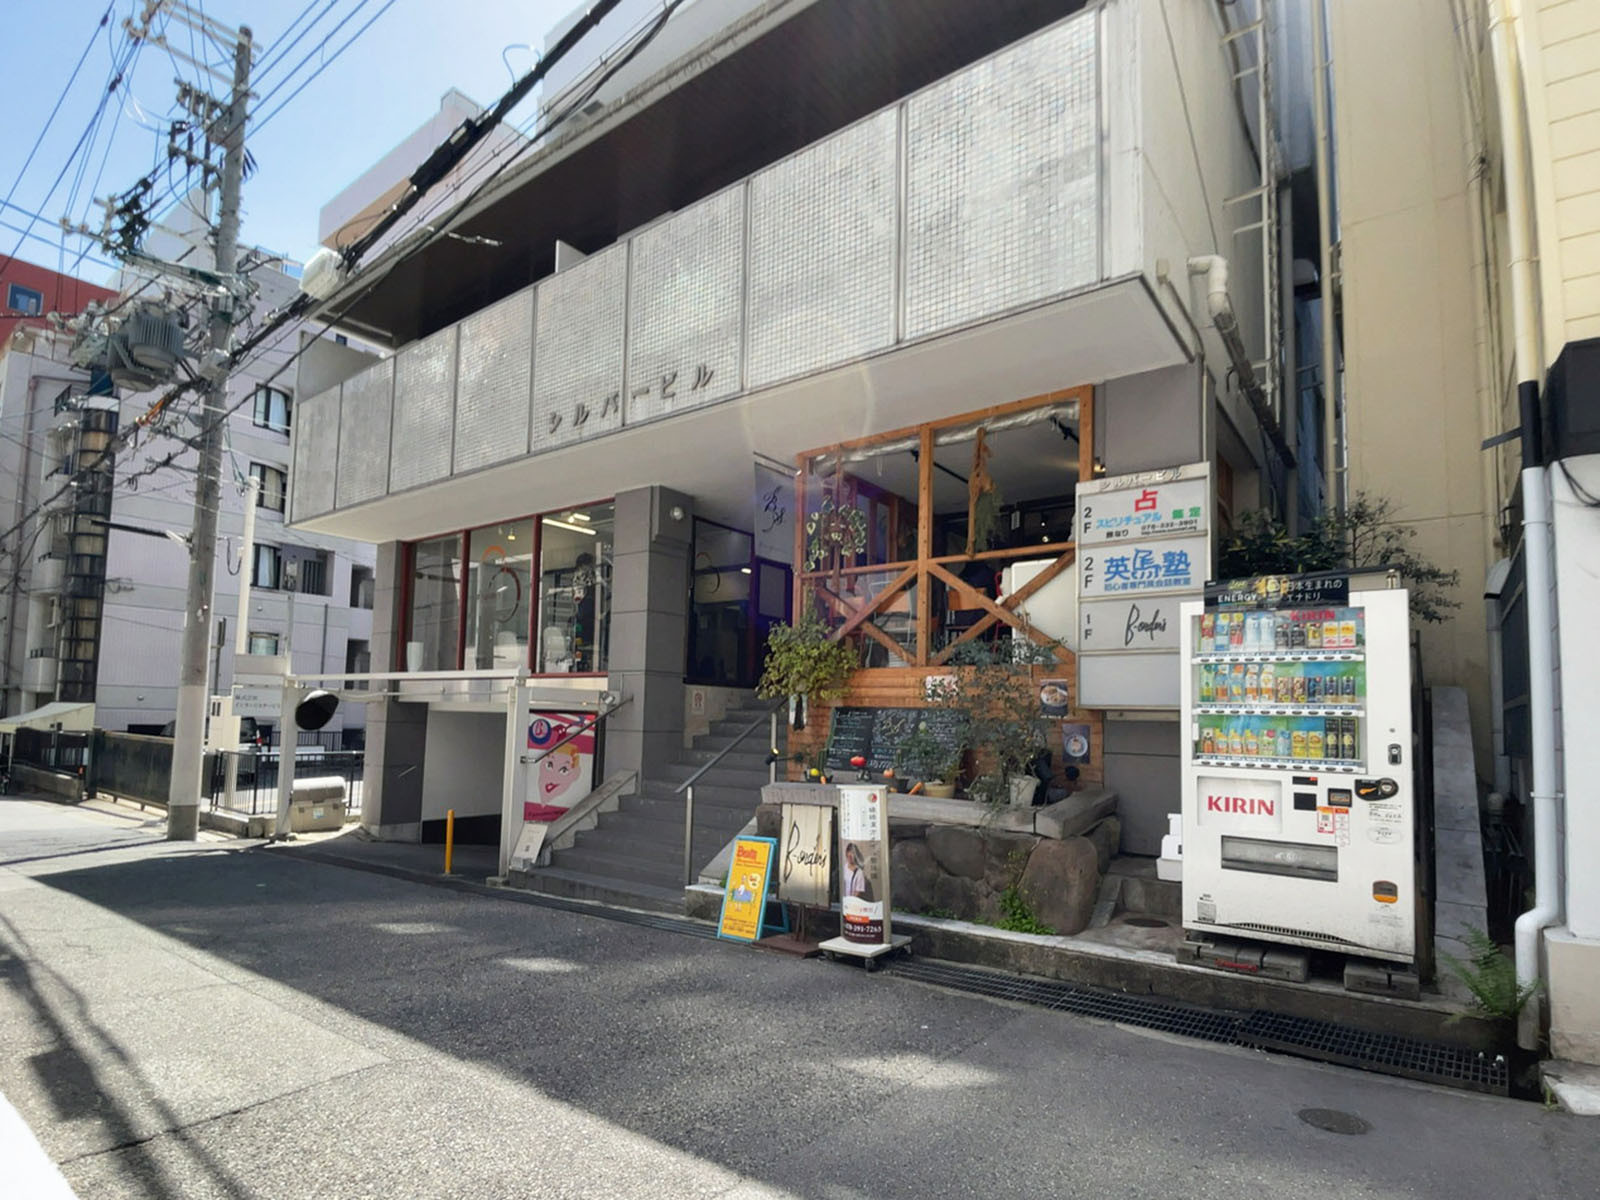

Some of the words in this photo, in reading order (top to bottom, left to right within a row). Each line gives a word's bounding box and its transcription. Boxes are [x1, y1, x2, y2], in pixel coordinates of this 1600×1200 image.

[1134, 489, 1159, 512] 占
[1217, 593, 1258, 603] ENERGY
[1207, 795, 1275, 817] KIRIN
